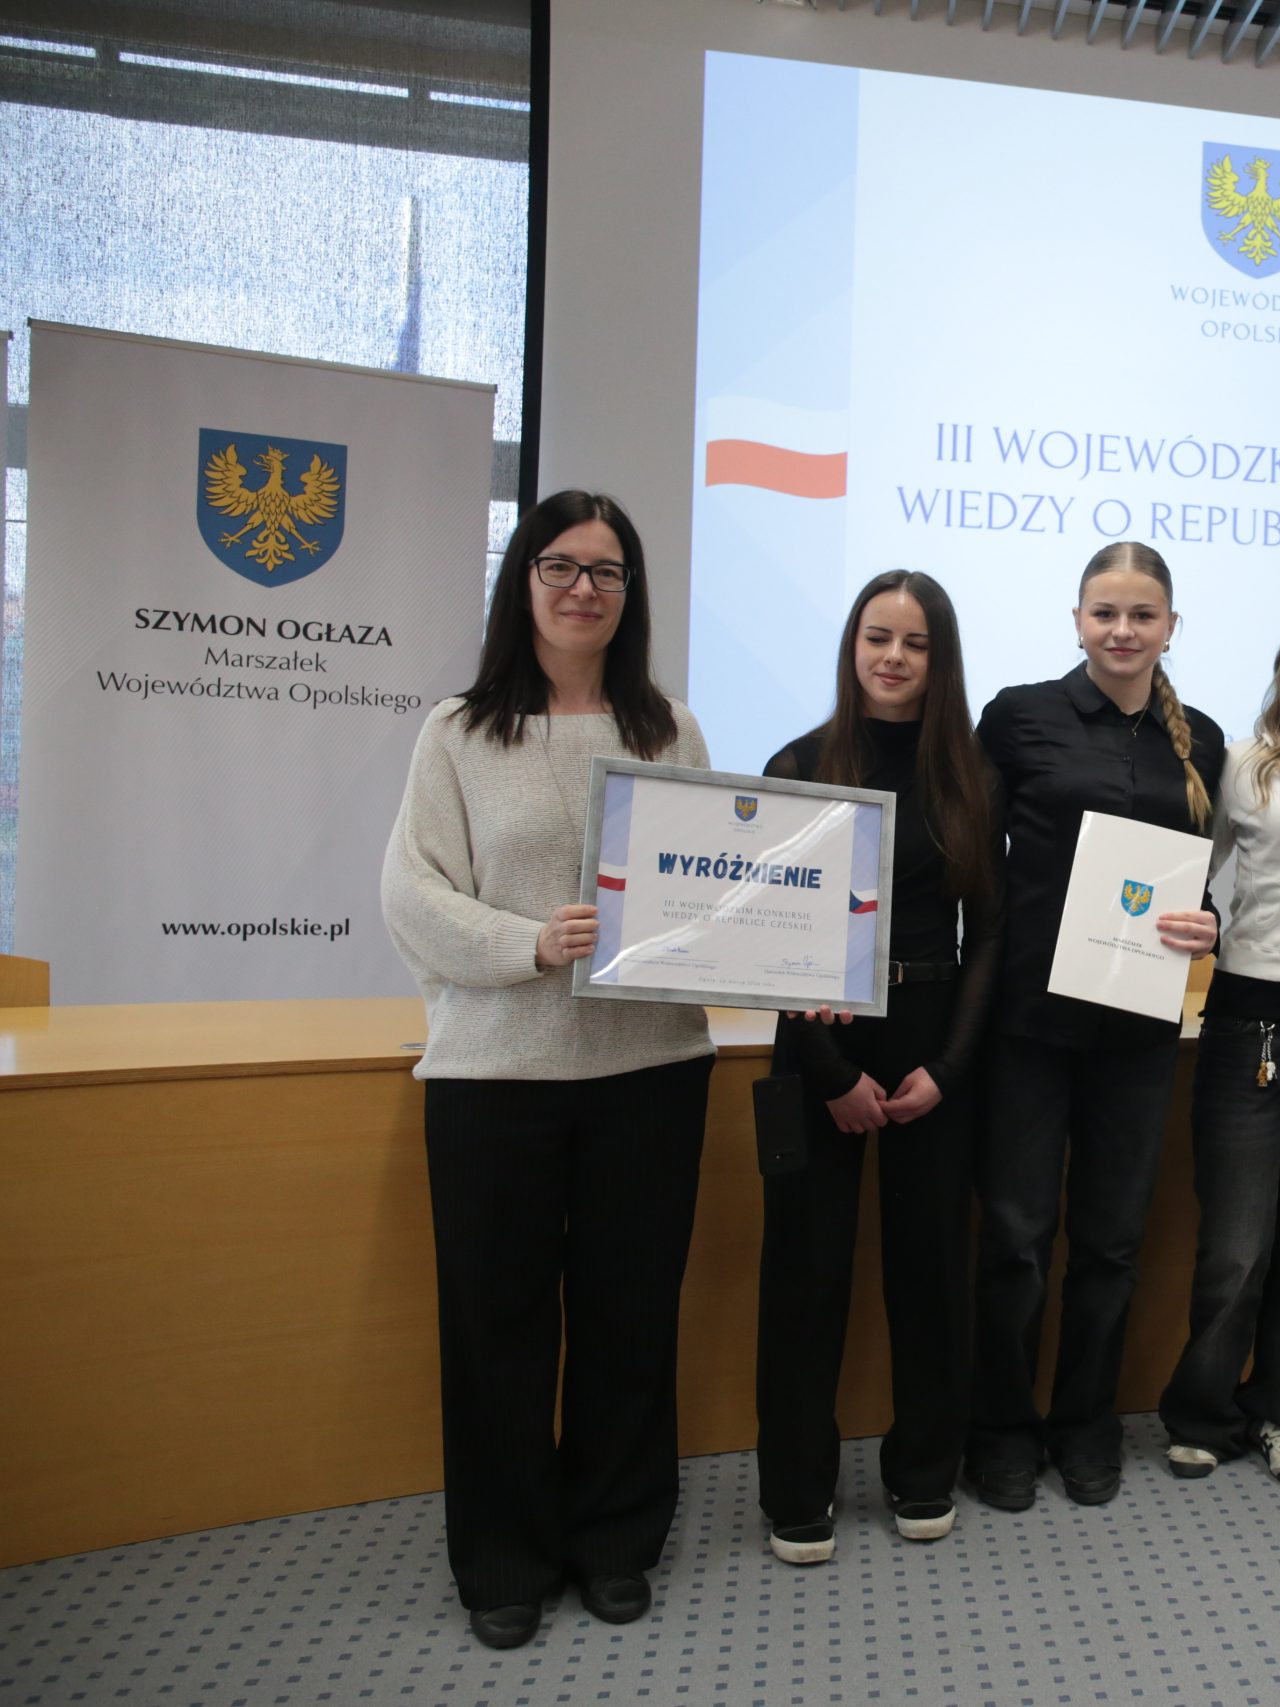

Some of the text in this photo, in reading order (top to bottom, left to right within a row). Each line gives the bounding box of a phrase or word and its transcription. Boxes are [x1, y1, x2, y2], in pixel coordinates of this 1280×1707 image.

[936, 423, 973, 462] III
[896, 486, 1075, 533] WIEDZY
[1093, 499, 1131, 537] O
[135, 608, 393, 646] SZYMON OGŁAZA
[204, 647, 327, 672] Marszałek
[97, 671, 421, 714] Województwa Opolskiego
[658, 852, 823, 889] WYRÓŻNIENIE
[162, 918, 350, 941] www.opolskie.pl
[662, 910, 699, 921] WIEDZY
[757, 906, 811, 920] KONKURSIE
